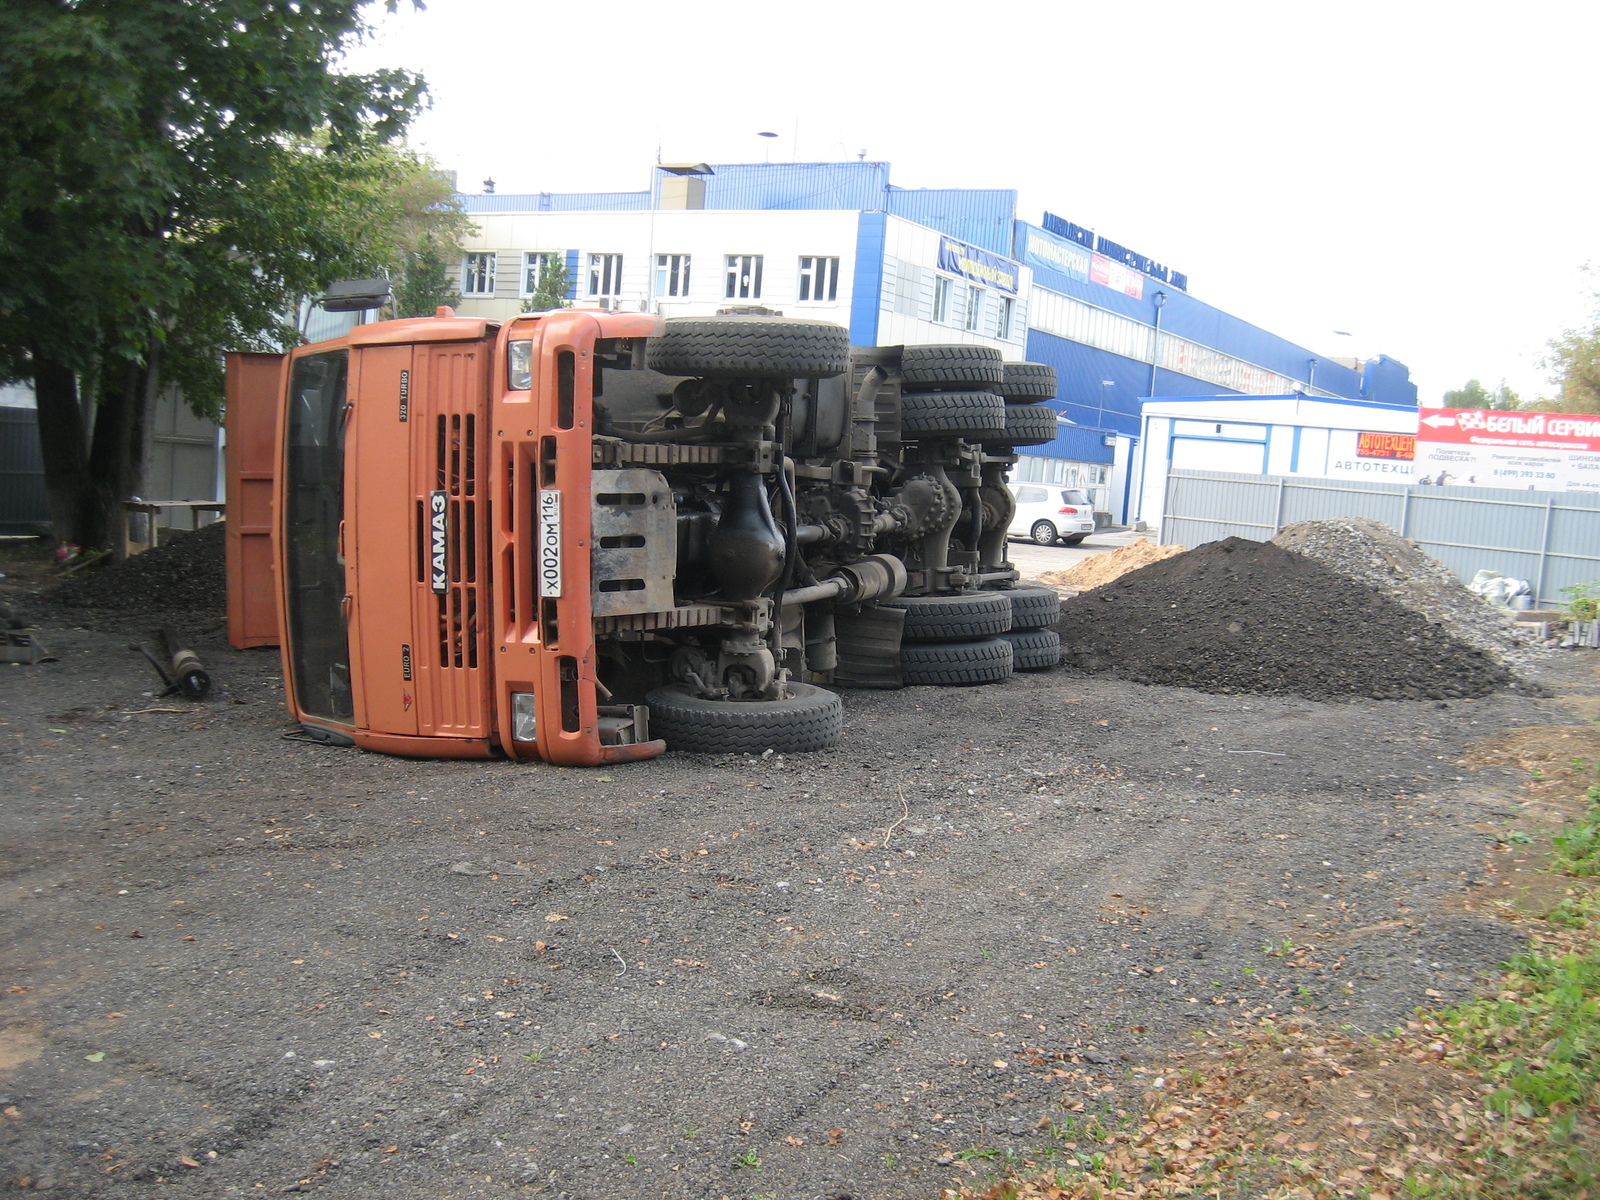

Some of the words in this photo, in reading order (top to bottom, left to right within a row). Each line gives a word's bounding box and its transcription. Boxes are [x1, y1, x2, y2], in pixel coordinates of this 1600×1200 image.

[1028, 233, 1089, 275] МОТОМАСТЕРСКАЯ
[1486, 415, 1545, 434] БЕЛЫЙ
[1395, 451, 1416, 459] 8-49
[1435, 448, 1470, 456] Полетела
[1516, 455, 1561, 463] автомобилей
[1335, 461, 1414, 475] АВТОТЕХЦ
[1577, 463, 1600, 471] БАЛА
[1499, 469, 1518, 478] (499)
[1520, 470, 1533, 478] 393
[542, 497, 554, 521] 116
[431, 494, 448, 590] КАМАЗ
